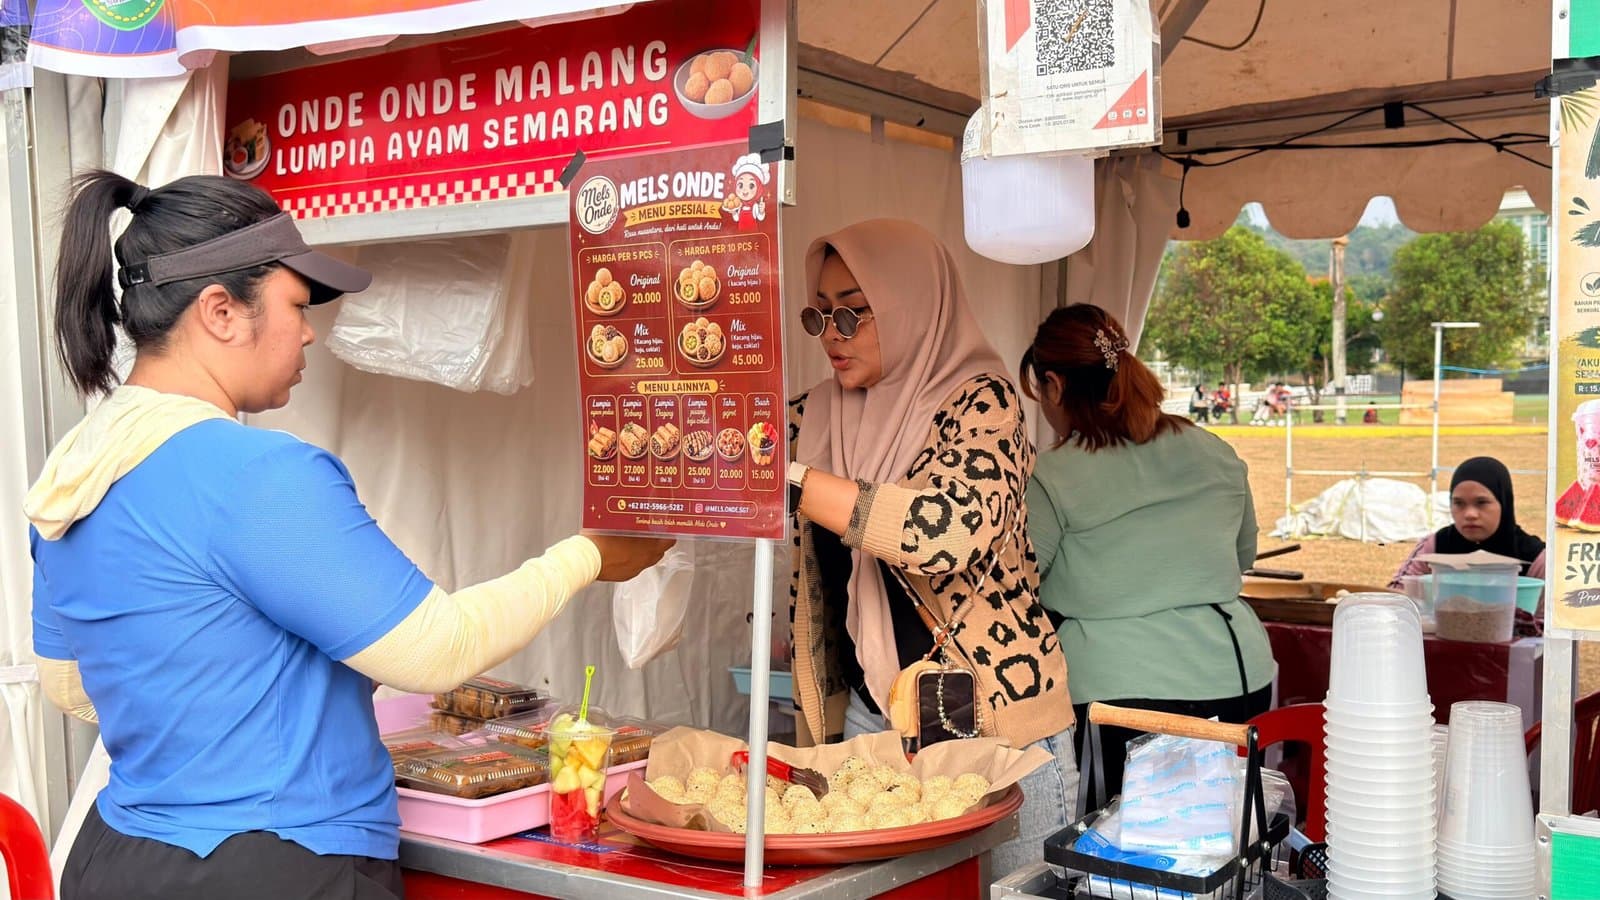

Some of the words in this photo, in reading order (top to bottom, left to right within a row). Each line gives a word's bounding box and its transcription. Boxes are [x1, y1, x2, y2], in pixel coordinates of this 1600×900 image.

[278, 92, 364, 138] ONDE
[380, 73, 476, 122] ONDE
[495, 40, 667, 106] MALANG
[276, 136, 375, 176] LUMPIA
[387, 123, 469, 161] AYAM
[483, 93, 668, 149] SEMARANG
[582, 184, 610, 207] Mels
[620, 174, 670, 208] MELS
[672, 172, 725, 199] ONDE
[585, 200, 612, 224] Onde
[638, 206, 666, 220] MENU
[669, 203, 708, 216] SPESIAL
[684, 246, 710, 256] HARGA
[712, 244, 726, 254] PER
[728, 243, 736, 252] 10
[738, 242, 752, 252] PCS
[592, 253, 616, 263] HARGA
[618, 252, 631, 261] PER
[632, 252, 638, 260] 5
[639, 250, 653, 260] PCS
[727, 264, 760, 280] Original
[630, 272, 660, 288] Original
[632, 292, 662, 304] 20.000
[729, 292, 761, 304] 35.000
[634, 323, 649, 336] Mix
[730, 319, 746, 332] Mix
[636, 357, 664, 368] 25.000
[732, 354, 764, 366] 45.000
[644, 384, 669, 392] MENU
[672, 382, 710, 392] LAINNYA
[593, 464, 614, 474] 22.000
[624, 466, 646, 474] 27.000
[655, 466, 678, 475] 25.000
[688, 466, 711, 476] 25.000
[720, 469, 743, 478] 20.000
[752, 470, 774, 480] 15.000
[1580, 564, 1600, 584] Y
